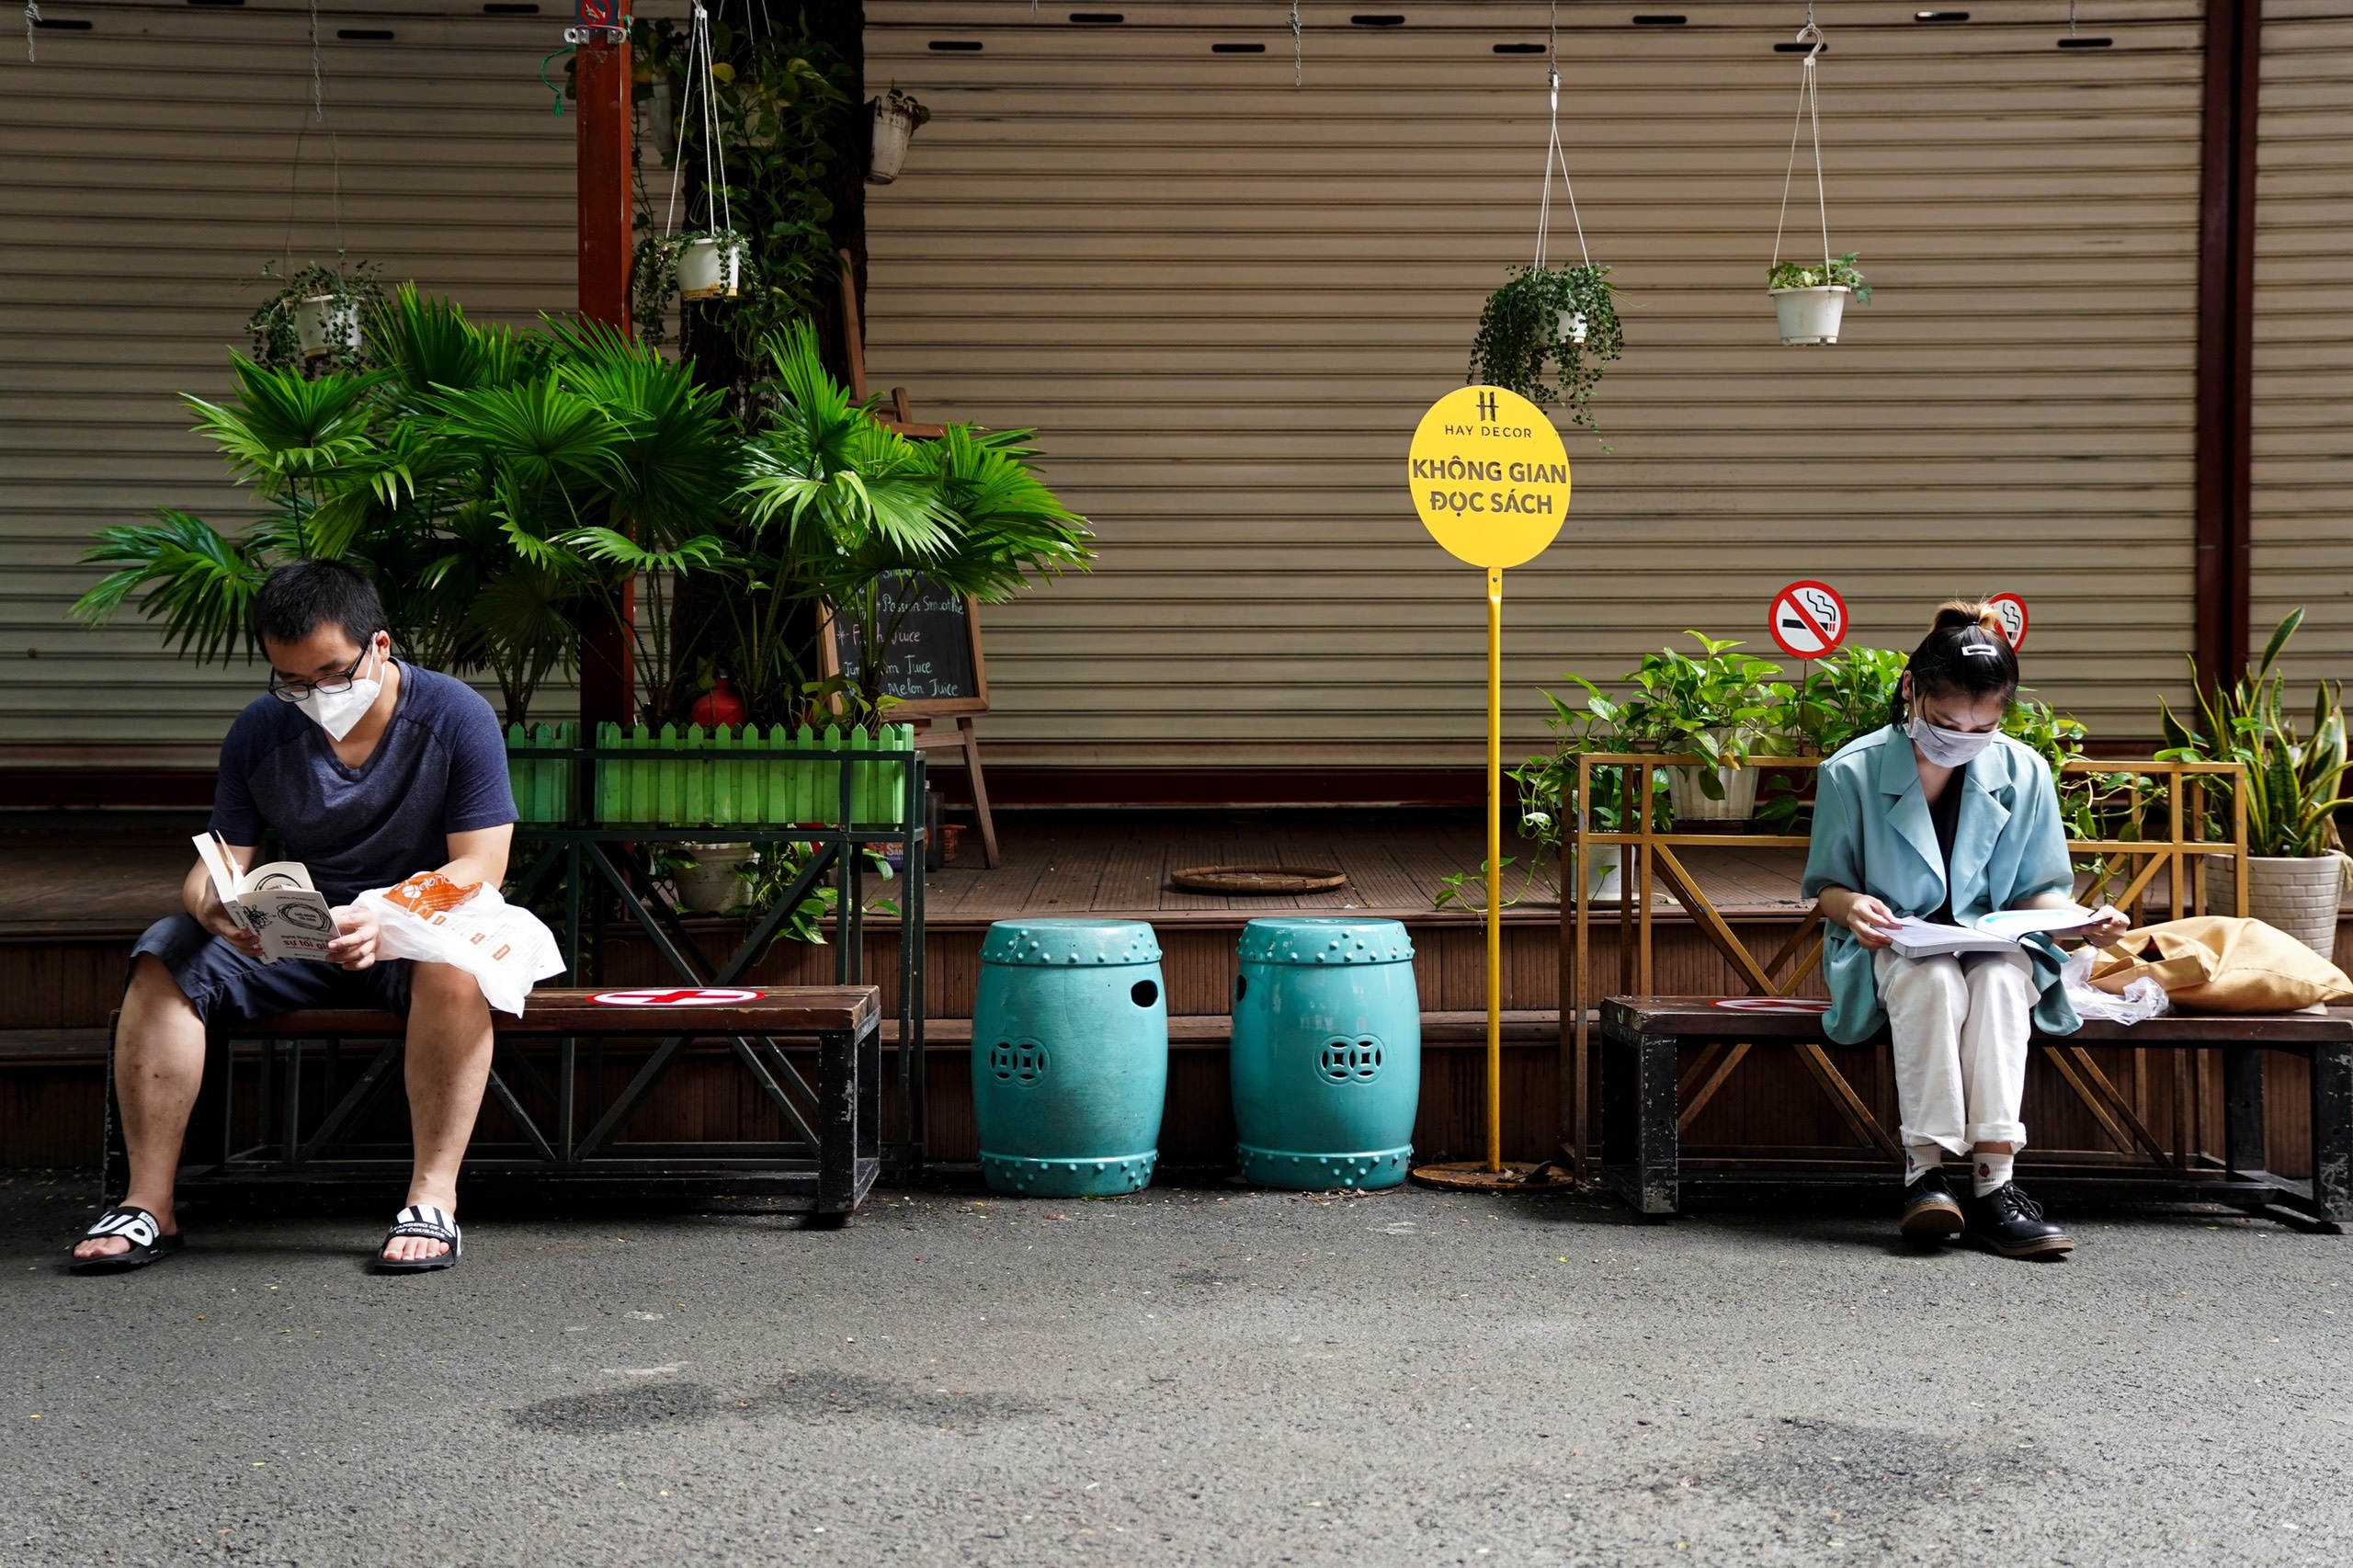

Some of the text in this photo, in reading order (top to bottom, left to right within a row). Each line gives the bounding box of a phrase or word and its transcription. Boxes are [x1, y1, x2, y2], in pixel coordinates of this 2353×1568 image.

[1445, 425, 1532, 438] HAY DECOR
[1413, 455, 1567, 483] KHÔNG GIAN
[1430, 489, 1552, 517] ĐỌC SÁCH
[881, 593, 921, 612] Passin
[407, 1227, 446, 1238] COURAGE
